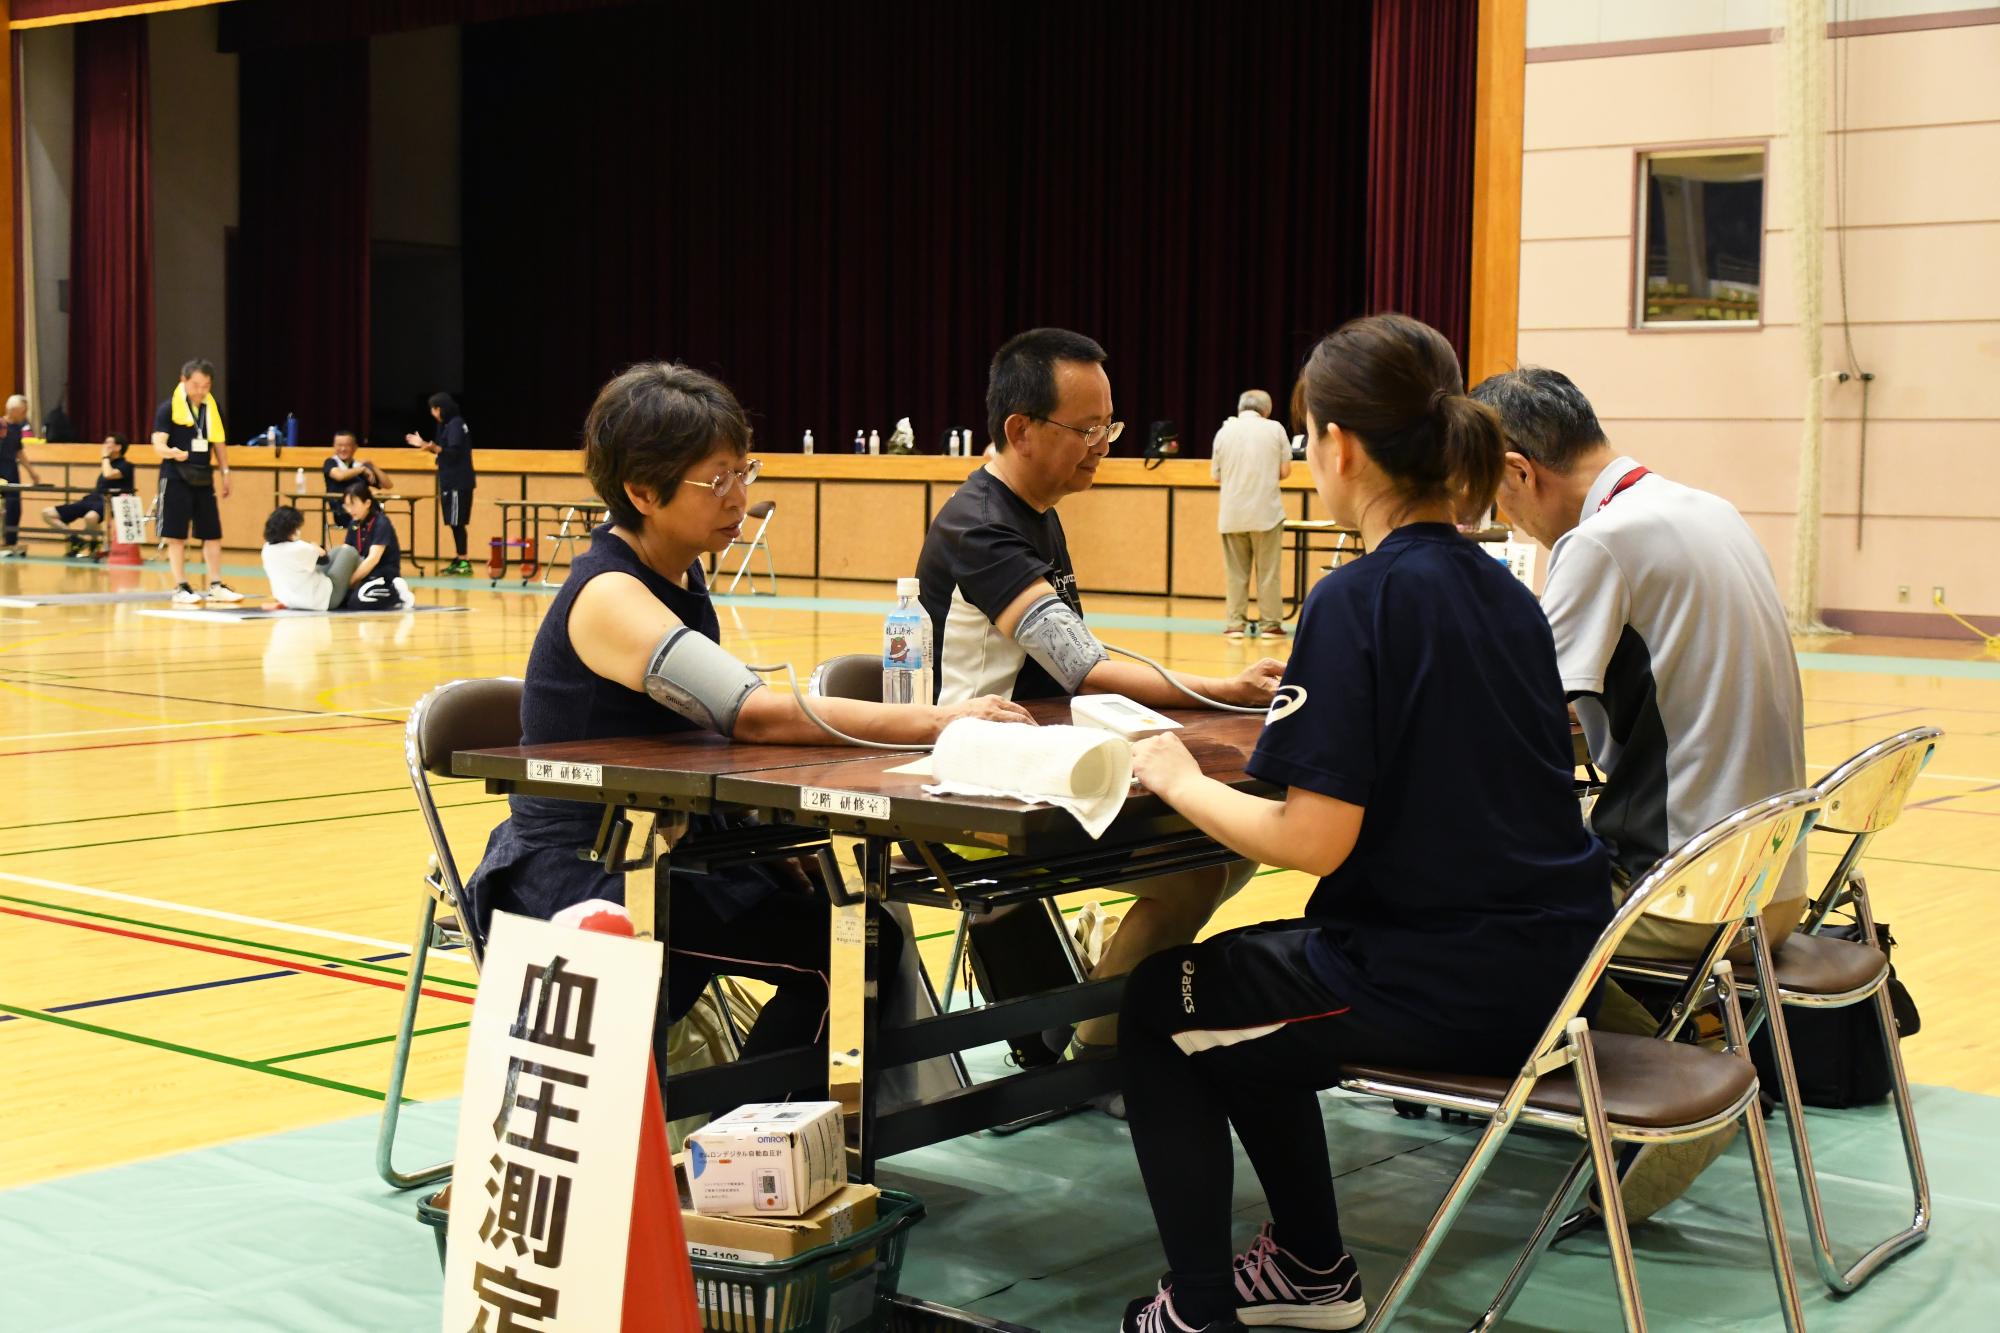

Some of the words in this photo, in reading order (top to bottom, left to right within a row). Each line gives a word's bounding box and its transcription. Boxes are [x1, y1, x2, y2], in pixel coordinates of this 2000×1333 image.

[536, 764, 553, 779] 2階
[560, 764, 594, 781] 研修室
[811, 791, 832, 809] 2階
[840, 796, 879, 814] 研修室
[1182, 975, 1195, 1014] asics
[467, 955, 599, 1333] 血圧測定
